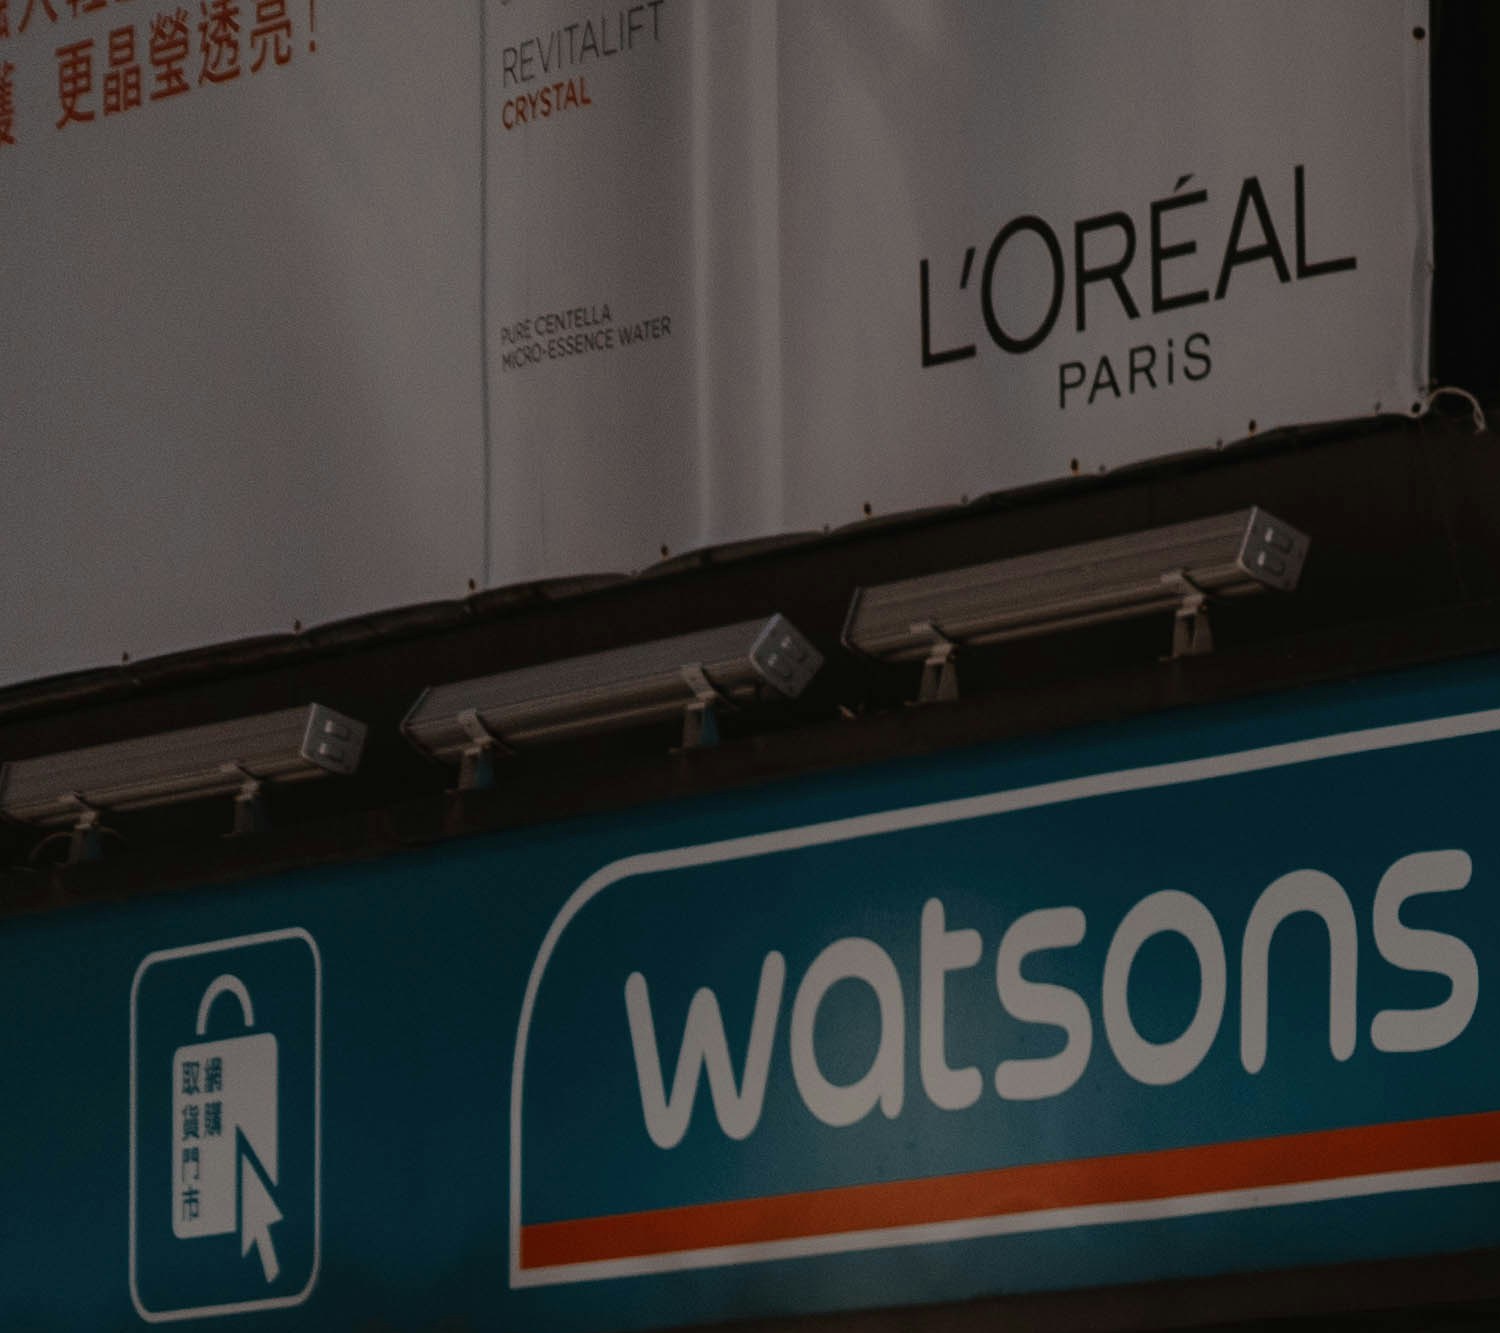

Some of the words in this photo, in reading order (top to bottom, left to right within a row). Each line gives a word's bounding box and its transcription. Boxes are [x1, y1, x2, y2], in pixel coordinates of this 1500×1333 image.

[504, 0, 664, 88] REVITALIFT
[503, 76, 592, 130] CRYSTAL
[918, 164, 1357, 369] L'ORÉAL
[618, 315, 671, 346] WATER
[622, 846, 1479, 1150] watsons
